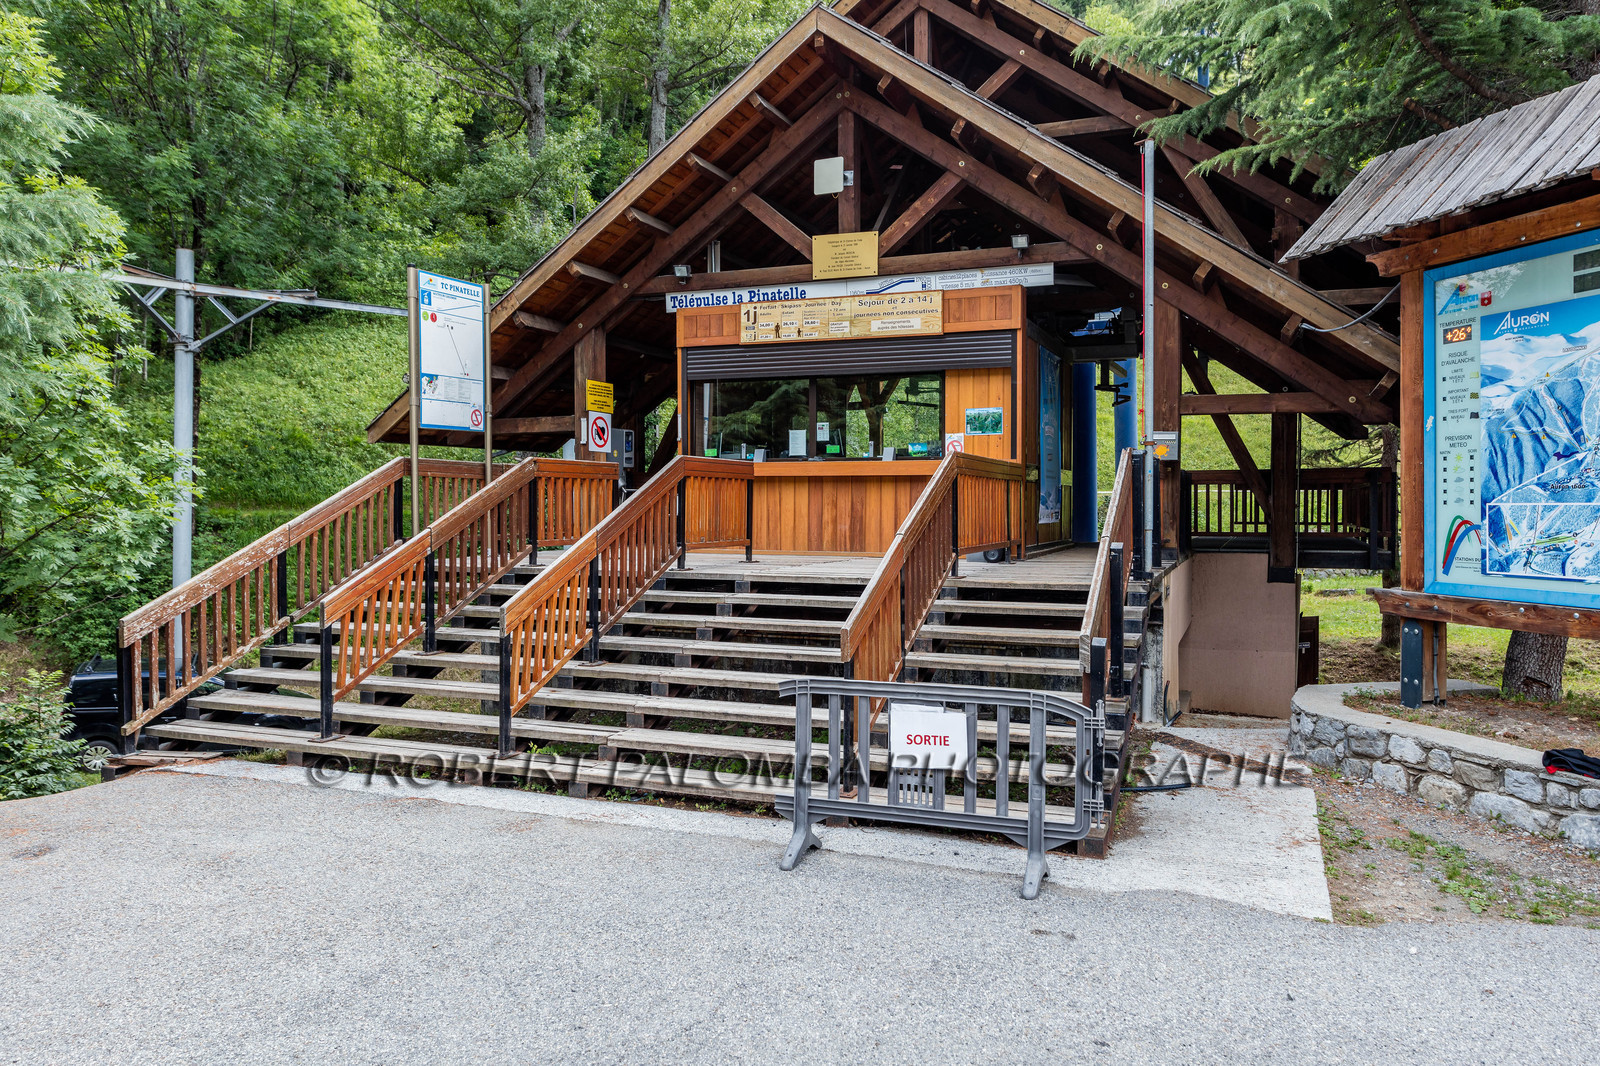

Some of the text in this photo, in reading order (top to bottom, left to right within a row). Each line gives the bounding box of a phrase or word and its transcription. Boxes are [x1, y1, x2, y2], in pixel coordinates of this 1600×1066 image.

[981, 270, 1007, 278] puissance
[450, 284, 480, 297] PINATELLE
[670, 286, 807, 308] Télépulse la Pinatelle
[1440, 317, 1476, 328] TEMPERATURE
[1494, 312, 1550, 335] AURON
[1441, 356, 1475, 366] D'AVALANCHE
[906, 734, 950, 746] SORTIE
